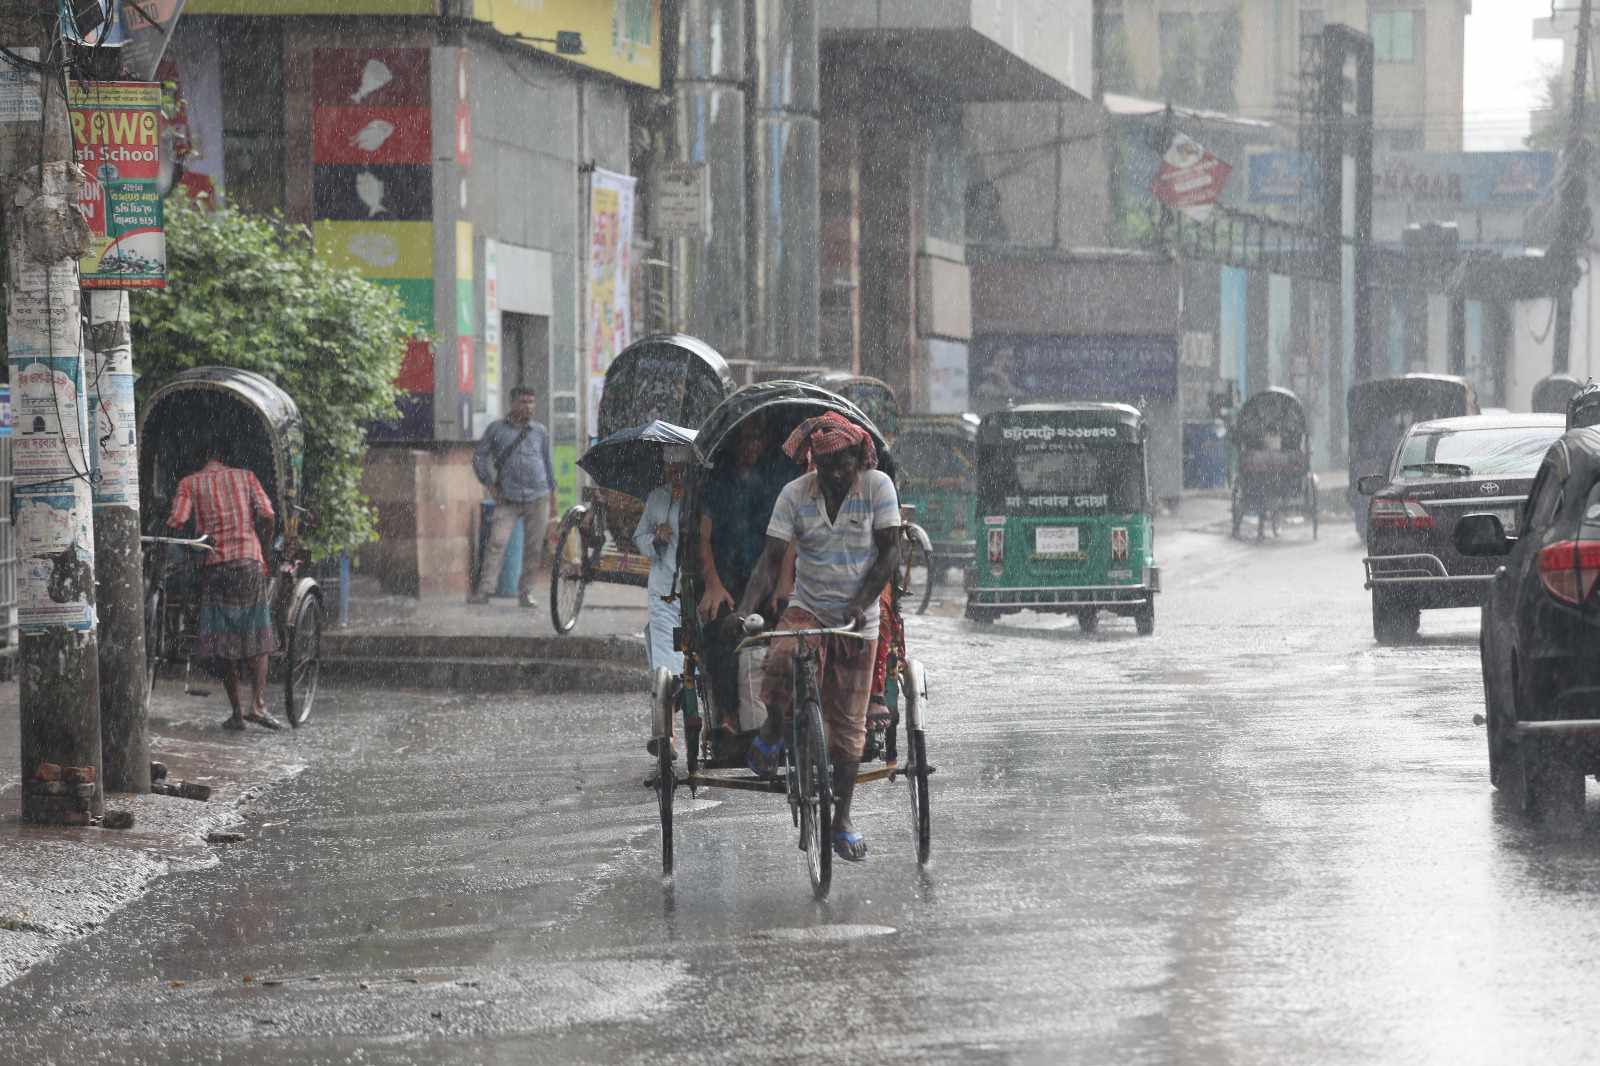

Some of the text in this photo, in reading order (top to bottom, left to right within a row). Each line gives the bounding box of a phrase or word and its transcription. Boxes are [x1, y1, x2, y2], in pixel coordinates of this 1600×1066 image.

[76, 146, 159, 161] sh School
[78, 182, 101, 201] ION
